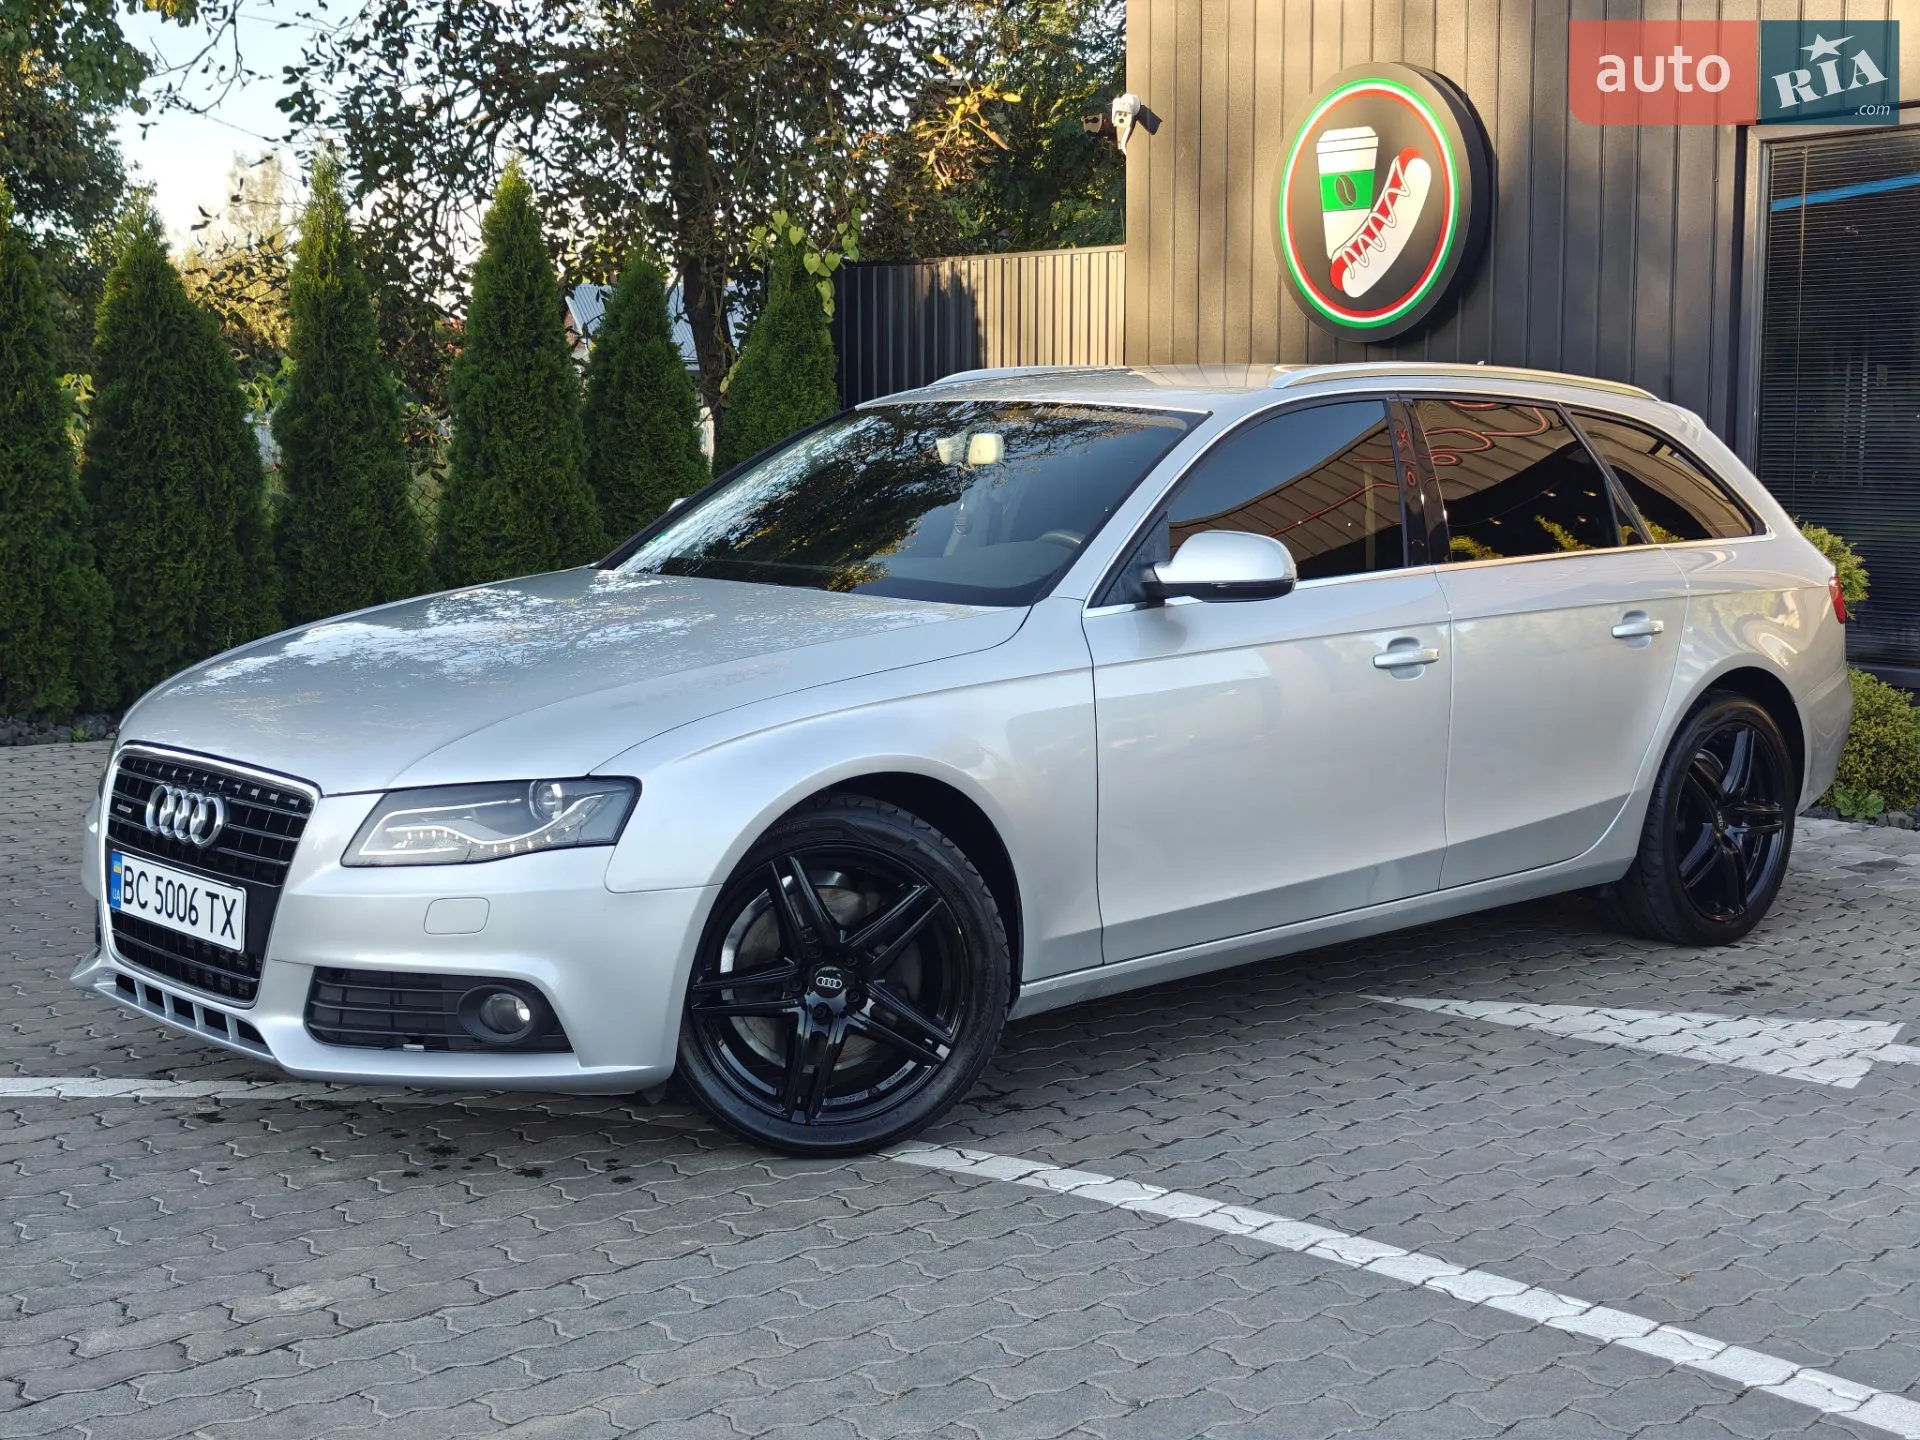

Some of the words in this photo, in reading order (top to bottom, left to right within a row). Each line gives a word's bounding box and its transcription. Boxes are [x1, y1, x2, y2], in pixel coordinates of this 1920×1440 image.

[112, 887, 121, 902] UA
[123, 865, 149, 910] BC
[154, 875, 199, 926] 5006
[205, 890, 237, 940] TX
